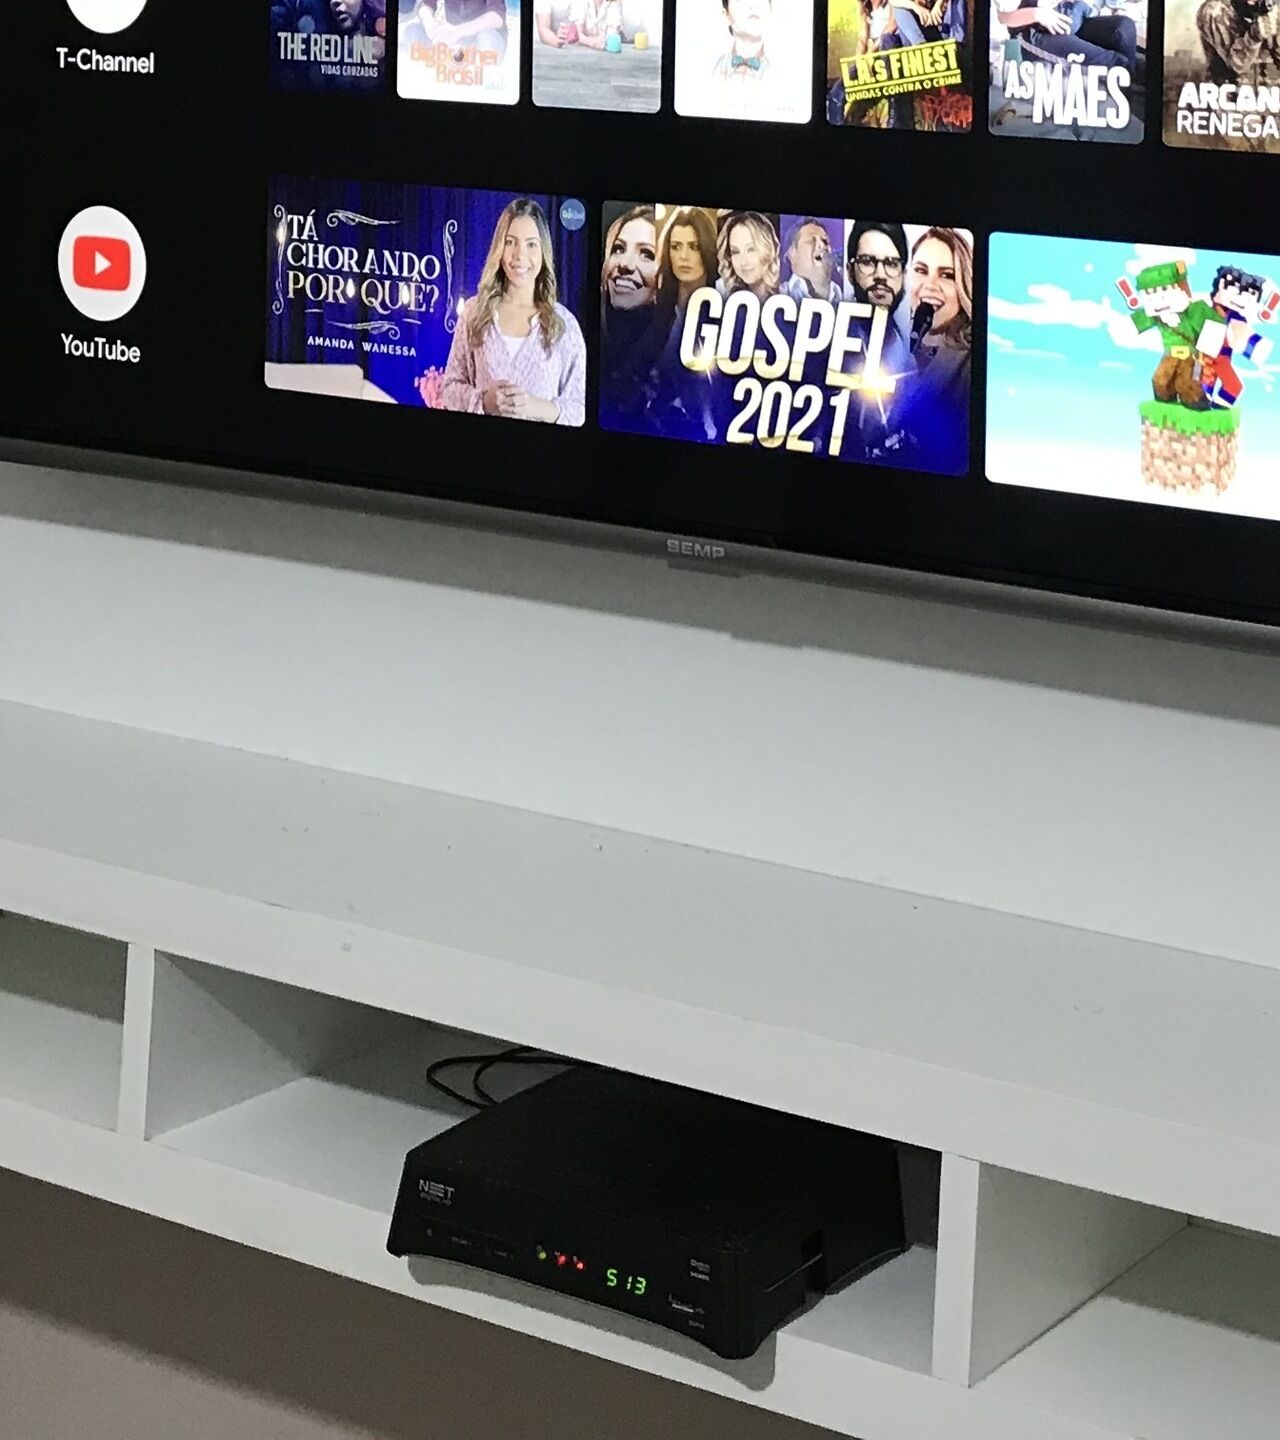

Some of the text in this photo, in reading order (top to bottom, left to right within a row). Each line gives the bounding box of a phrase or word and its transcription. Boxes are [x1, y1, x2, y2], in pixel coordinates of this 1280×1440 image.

[56, 46, 155, 74] T-Channel
[277, 32, 379, 65] THE RED LINE
[888, 43, 959, 80] FINEST
[320, 64, 379, 78] VIDAS CRUZADAS
[435, 63, 484, 87] Brasil
[845, 71, 963, 102] UNIDAS CONTRA O CRIME
[1004, 53, 1132, 130] AS MÃES
[286, 209, 319, 243] TÁ
[286, 242, 441, 281] CHORANDO
[286, 270, 440, 314] POR QUÊ?
[60, 333, 141, 363] YouTube
[306, 336, 417, 357] AMANDA WANESSA
[679, 287, 898, 393] GOSPEL
[726, 377, 851, 456] 2021
[666, 539, 725, 559] SEMP
[418, 1178, 455, 1199] NET
